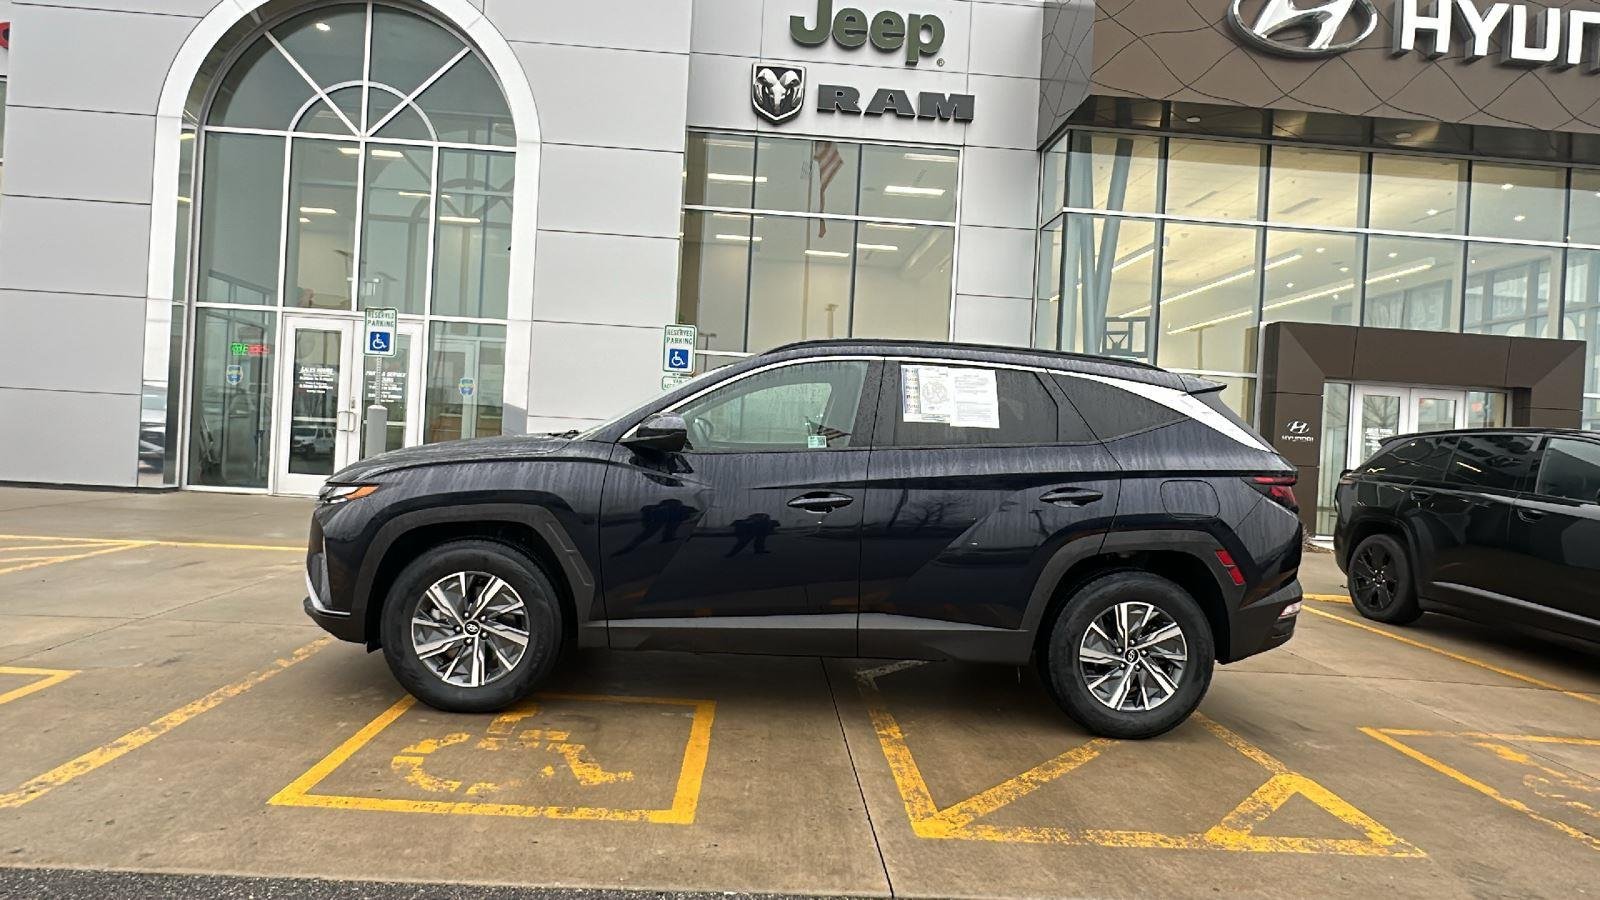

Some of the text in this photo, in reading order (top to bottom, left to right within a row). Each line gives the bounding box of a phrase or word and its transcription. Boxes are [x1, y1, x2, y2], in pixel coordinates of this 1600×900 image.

[790, 0, 945, 66] Jeep
[817, 84, 975, 123] RAM
[367, 311, 395, 319] RESERVED
[367, 319, 394, 328] PARKING
[667, 329, 693, 337] RESERVED
[666, 337, 693, 345] PARKING
[1281, 434, 1314, 442] HYUNDAI
